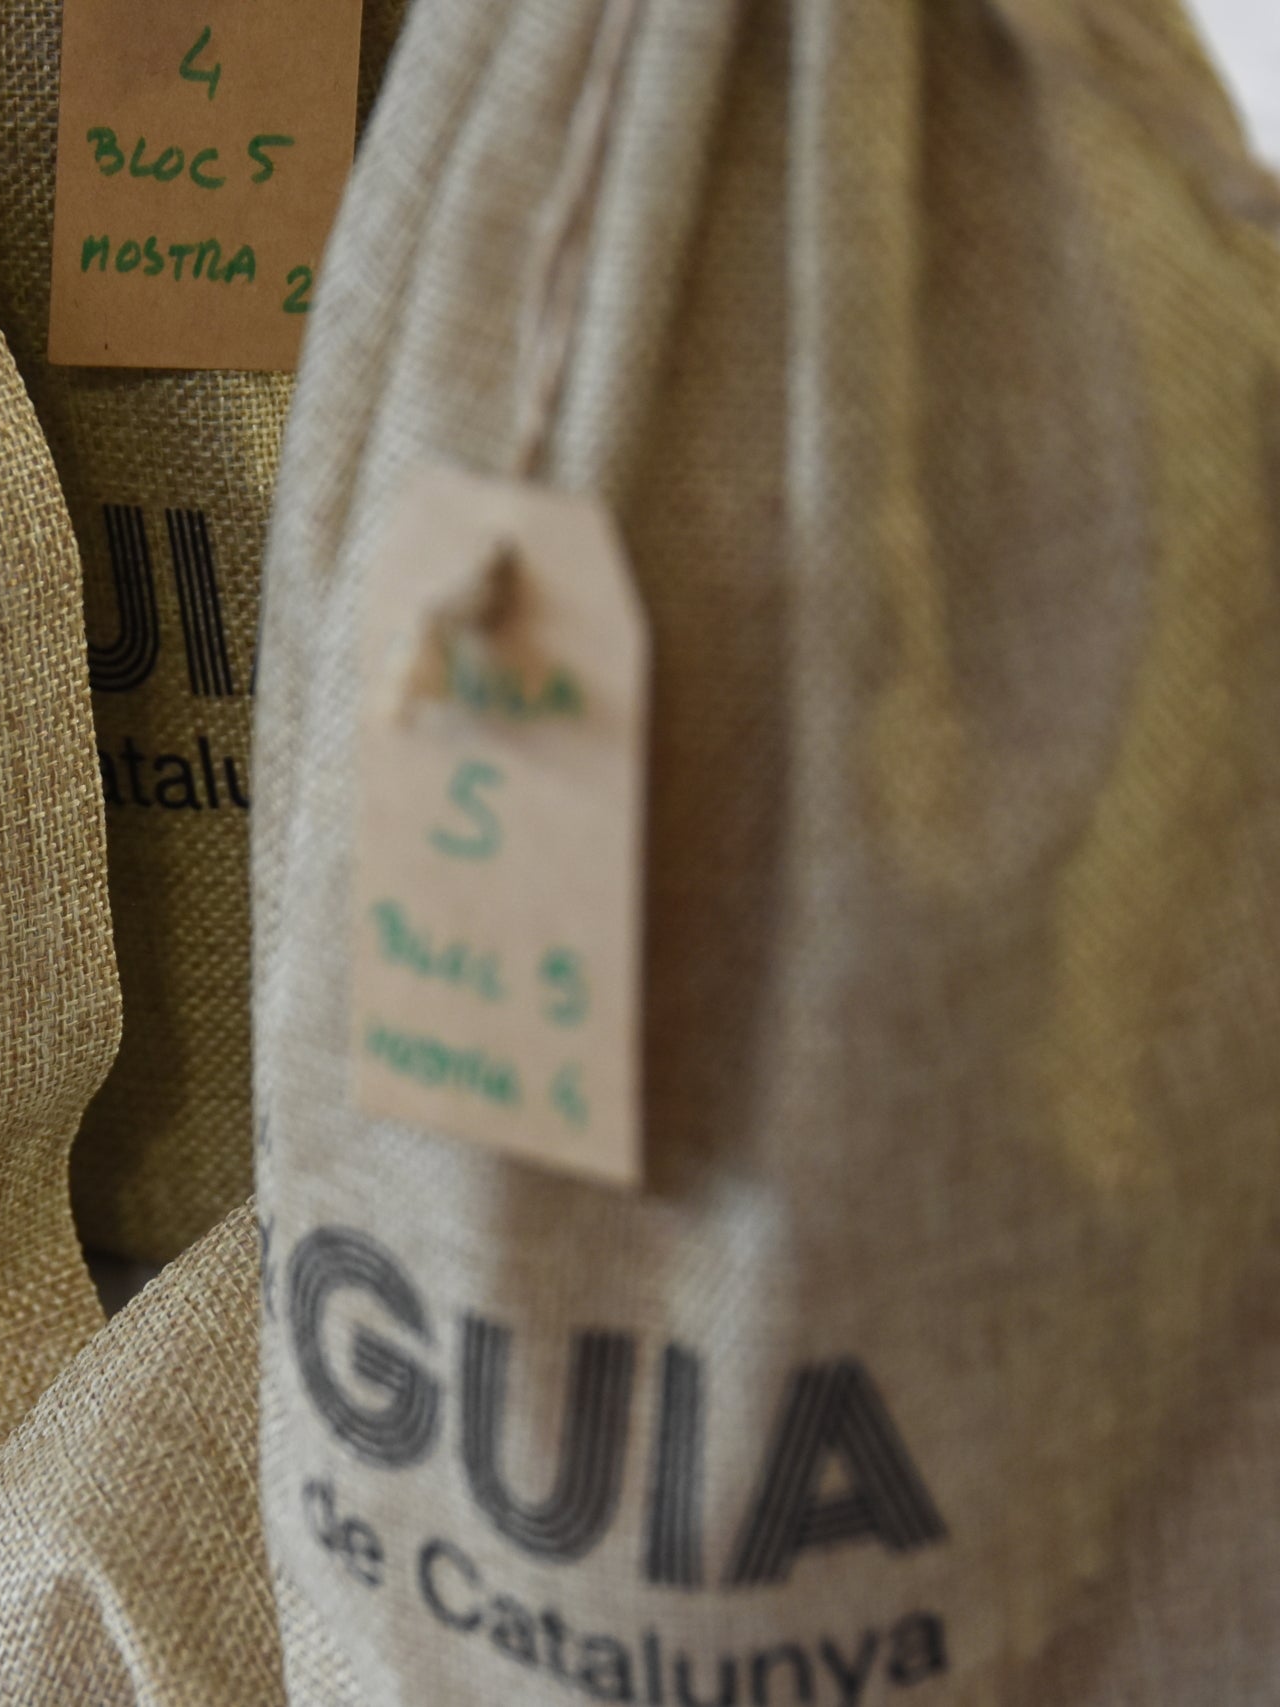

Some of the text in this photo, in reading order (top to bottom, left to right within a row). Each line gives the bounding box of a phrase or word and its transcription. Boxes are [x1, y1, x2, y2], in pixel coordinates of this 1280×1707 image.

[179, 25, 220, 100] 4
[87, 126, 296, 190] BLOC 5
[80, 235, 314, 314] MOSTRA 2
[285, 1225, 950, 1592] GUIA
[302, 1478, 948, 1707] de Catalunya
